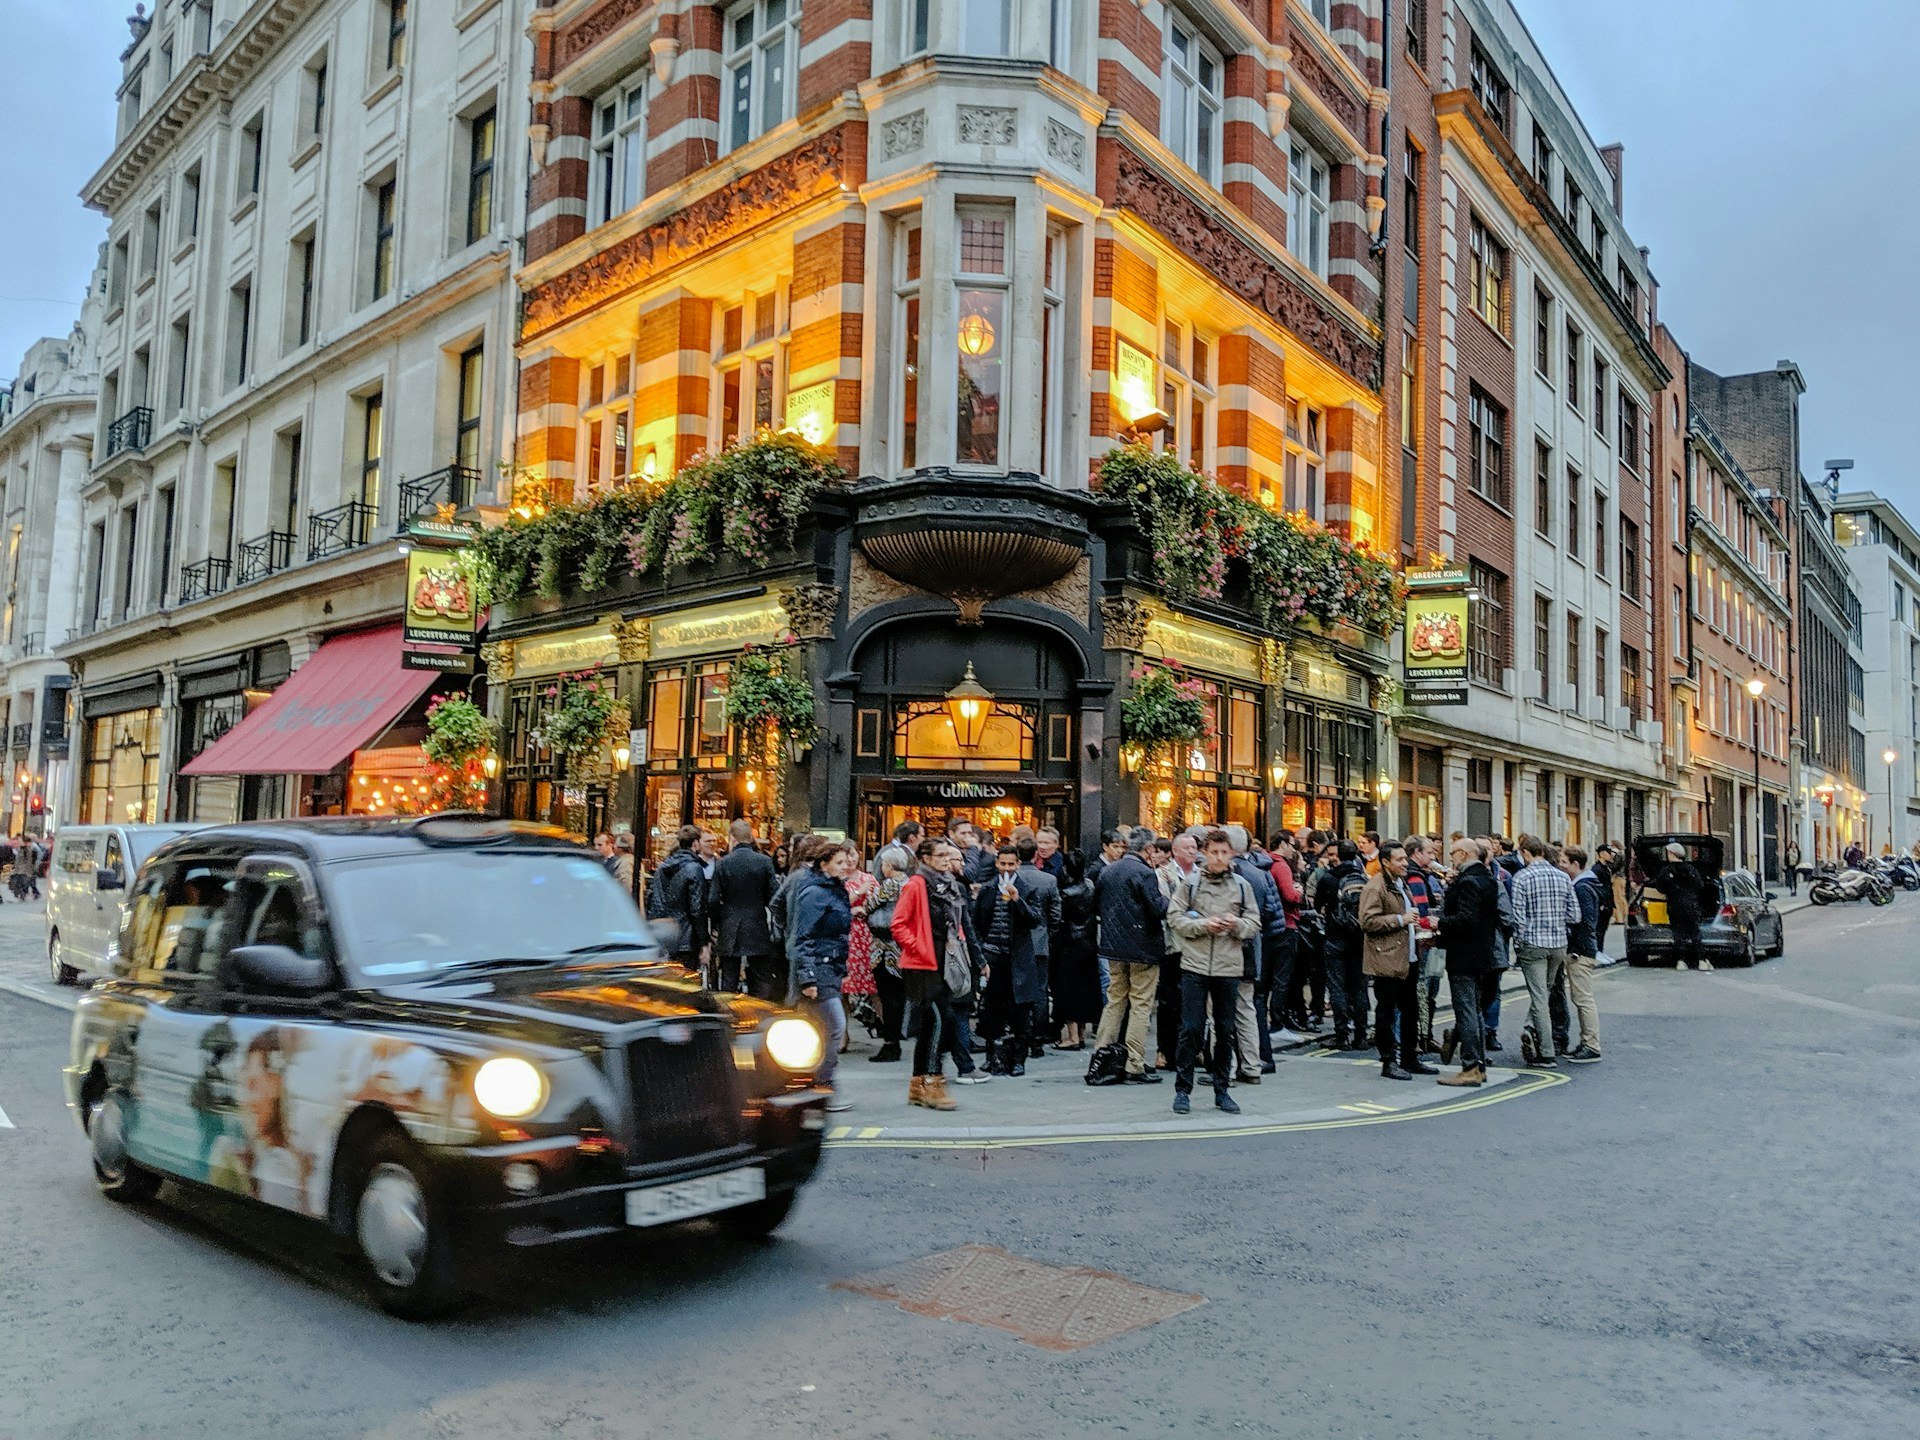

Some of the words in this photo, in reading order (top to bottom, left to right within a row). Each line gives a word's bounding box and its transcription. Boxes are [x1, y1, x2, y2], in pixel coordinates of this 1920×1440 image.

[417, 520, 452, 533] GREENE
[452, 524, 475, 535] KING
[1412, 570, 1442, 580] GREENE
[1443, 569, 1464, 578] KING
[409, 629, 449, 641] LEICESTER
[449, 632, 471, 642] ARMS
[1408, 668, 1444, 678] LEICESTER
[1443, 668, 1464, 676] ARMS
[940, 781, 1007, 798] GUINNESS
